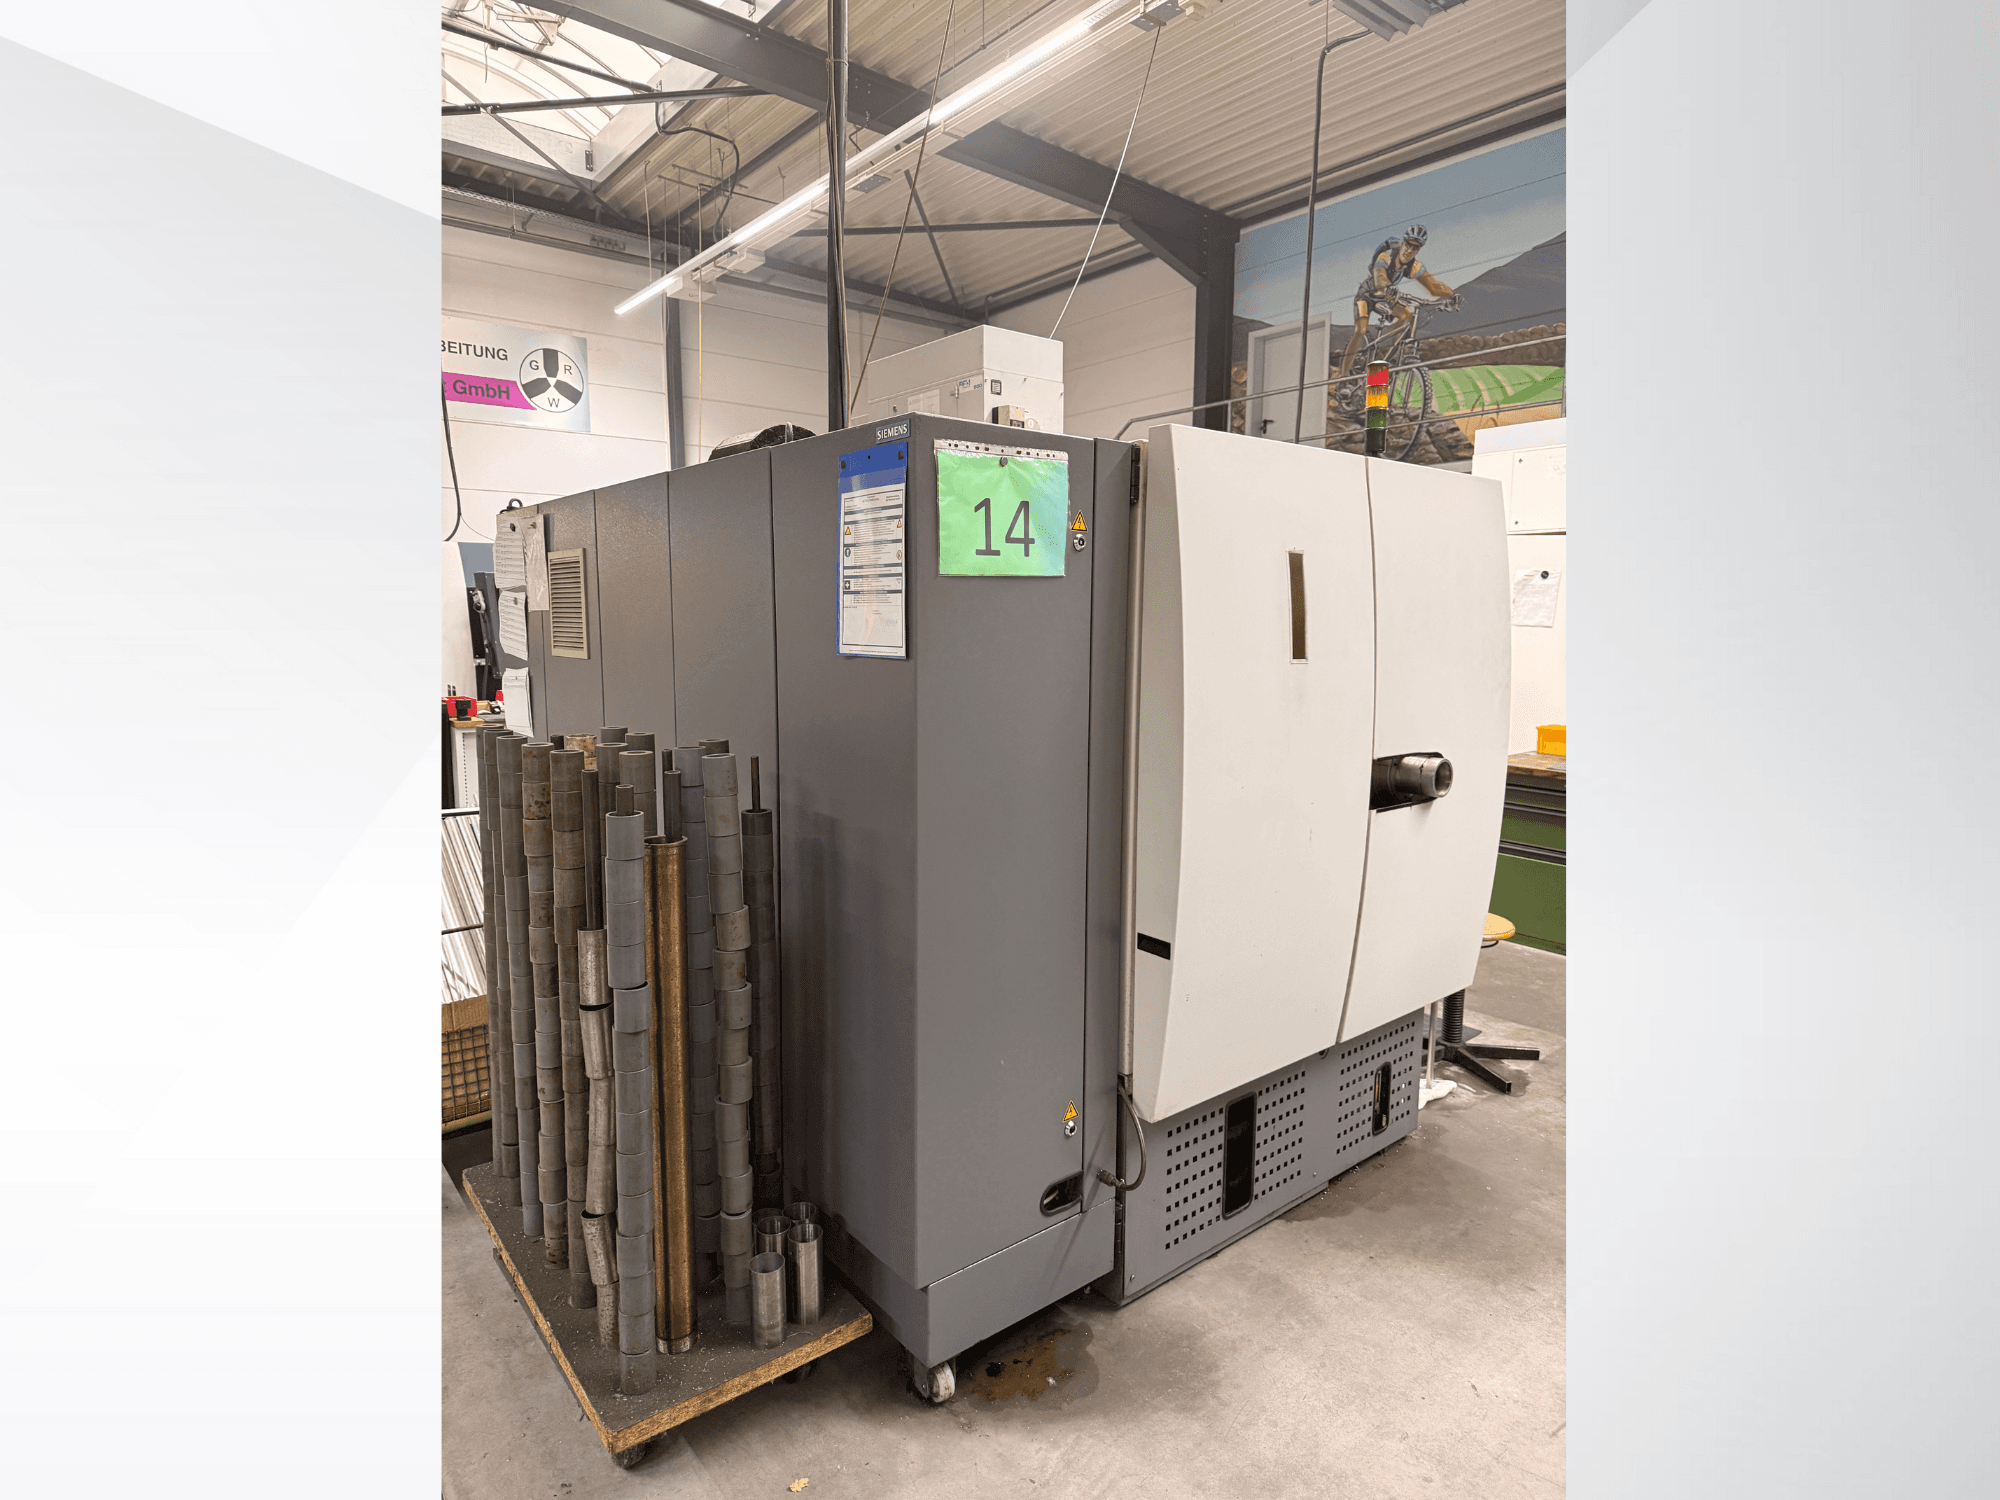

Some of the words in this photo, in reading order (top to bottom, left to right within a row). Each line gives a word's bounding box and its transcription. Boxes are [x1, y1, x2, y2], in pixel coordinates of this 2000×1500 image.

[529, 360, 539, 370] G
[563, 364, 573, 375] R
[452, 379, 510, 400] GmbH
[547, 397, 560, 408] W
[877, 423, 908, 440] SIEMENS
[974, 497, 1036, 558] 14
